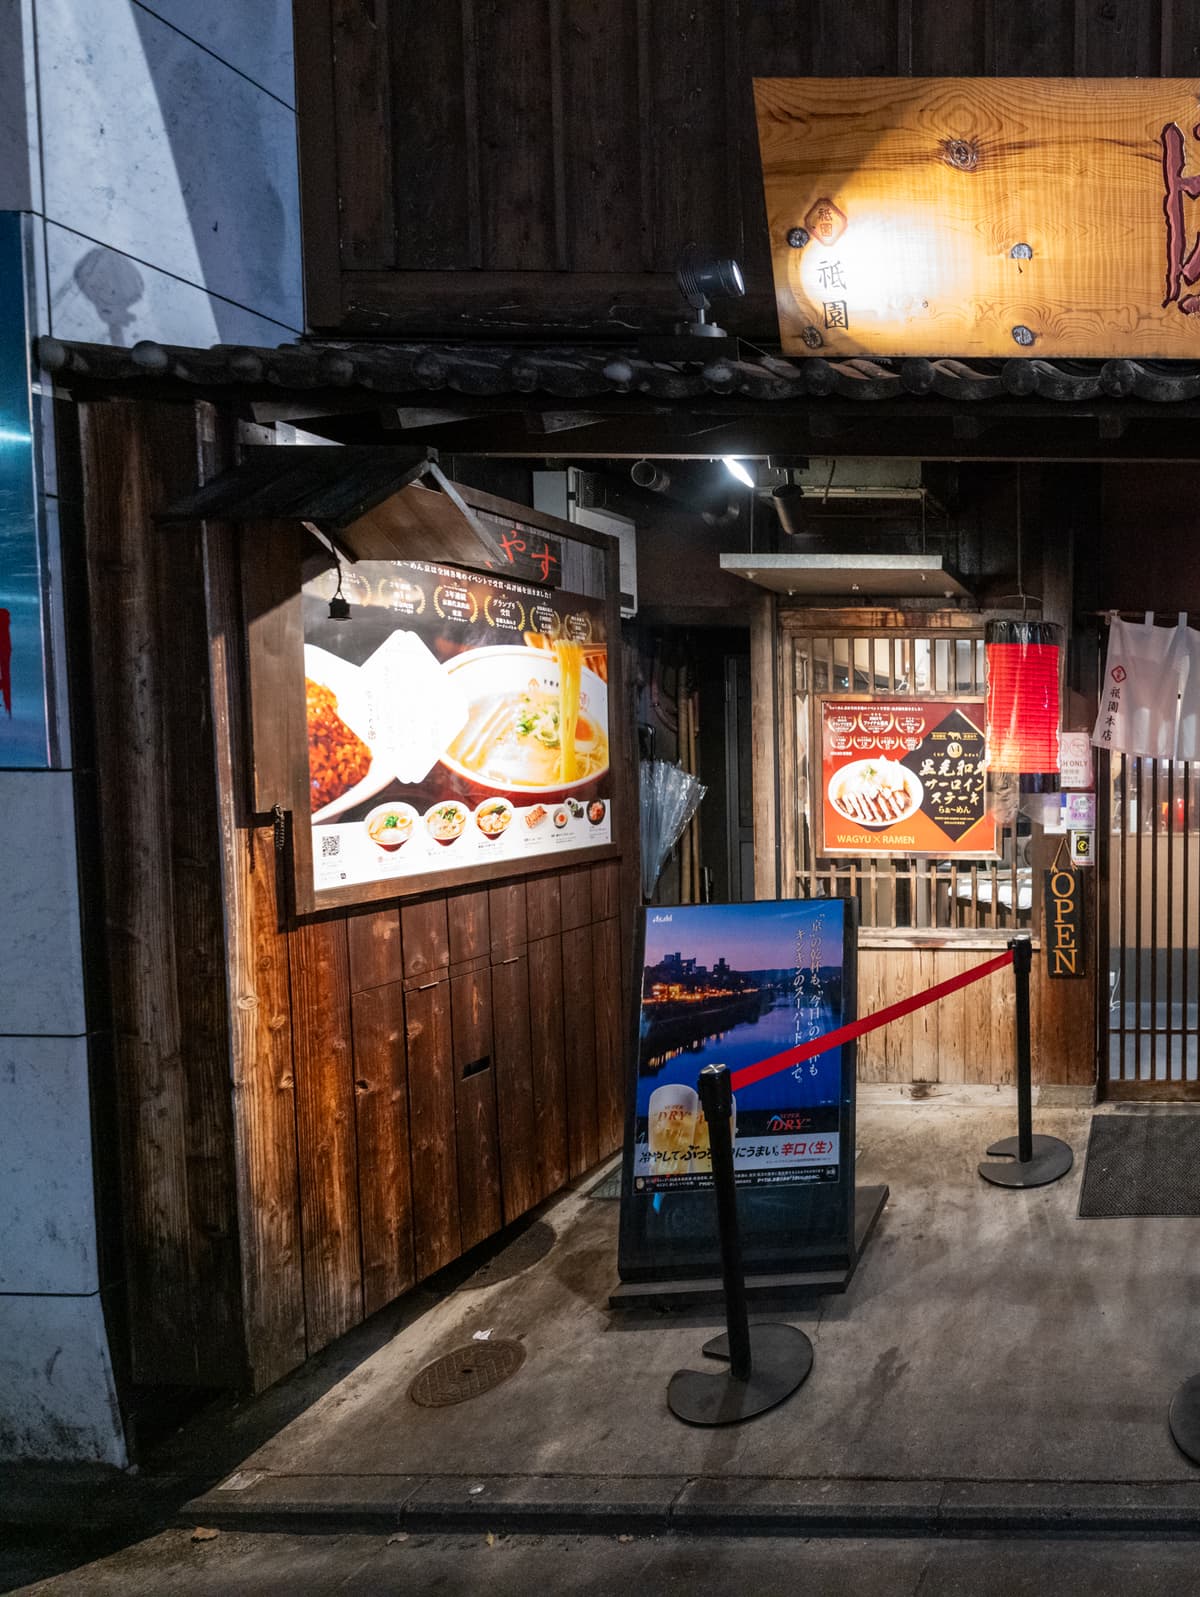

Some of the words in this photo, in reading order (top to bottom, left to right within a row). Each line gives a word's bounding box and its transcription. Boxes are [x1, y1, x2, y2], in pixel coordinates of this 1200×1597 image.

[816, 260, 850, 331] 祇園
[485, 529, 558, 580] やす
[924, 779, 985, 792] サーロイン
[931, 792, 980, 806] ステーキ
[837, 834, 871, 844] WAGYU
[882, 835, 915, 845] RAMEN
[1051, 872, 1076, 974] OPEN
[791, 929, 806, 1083] キンキンのスーパードで。
[772, 1117, 804, 1132] DRY
